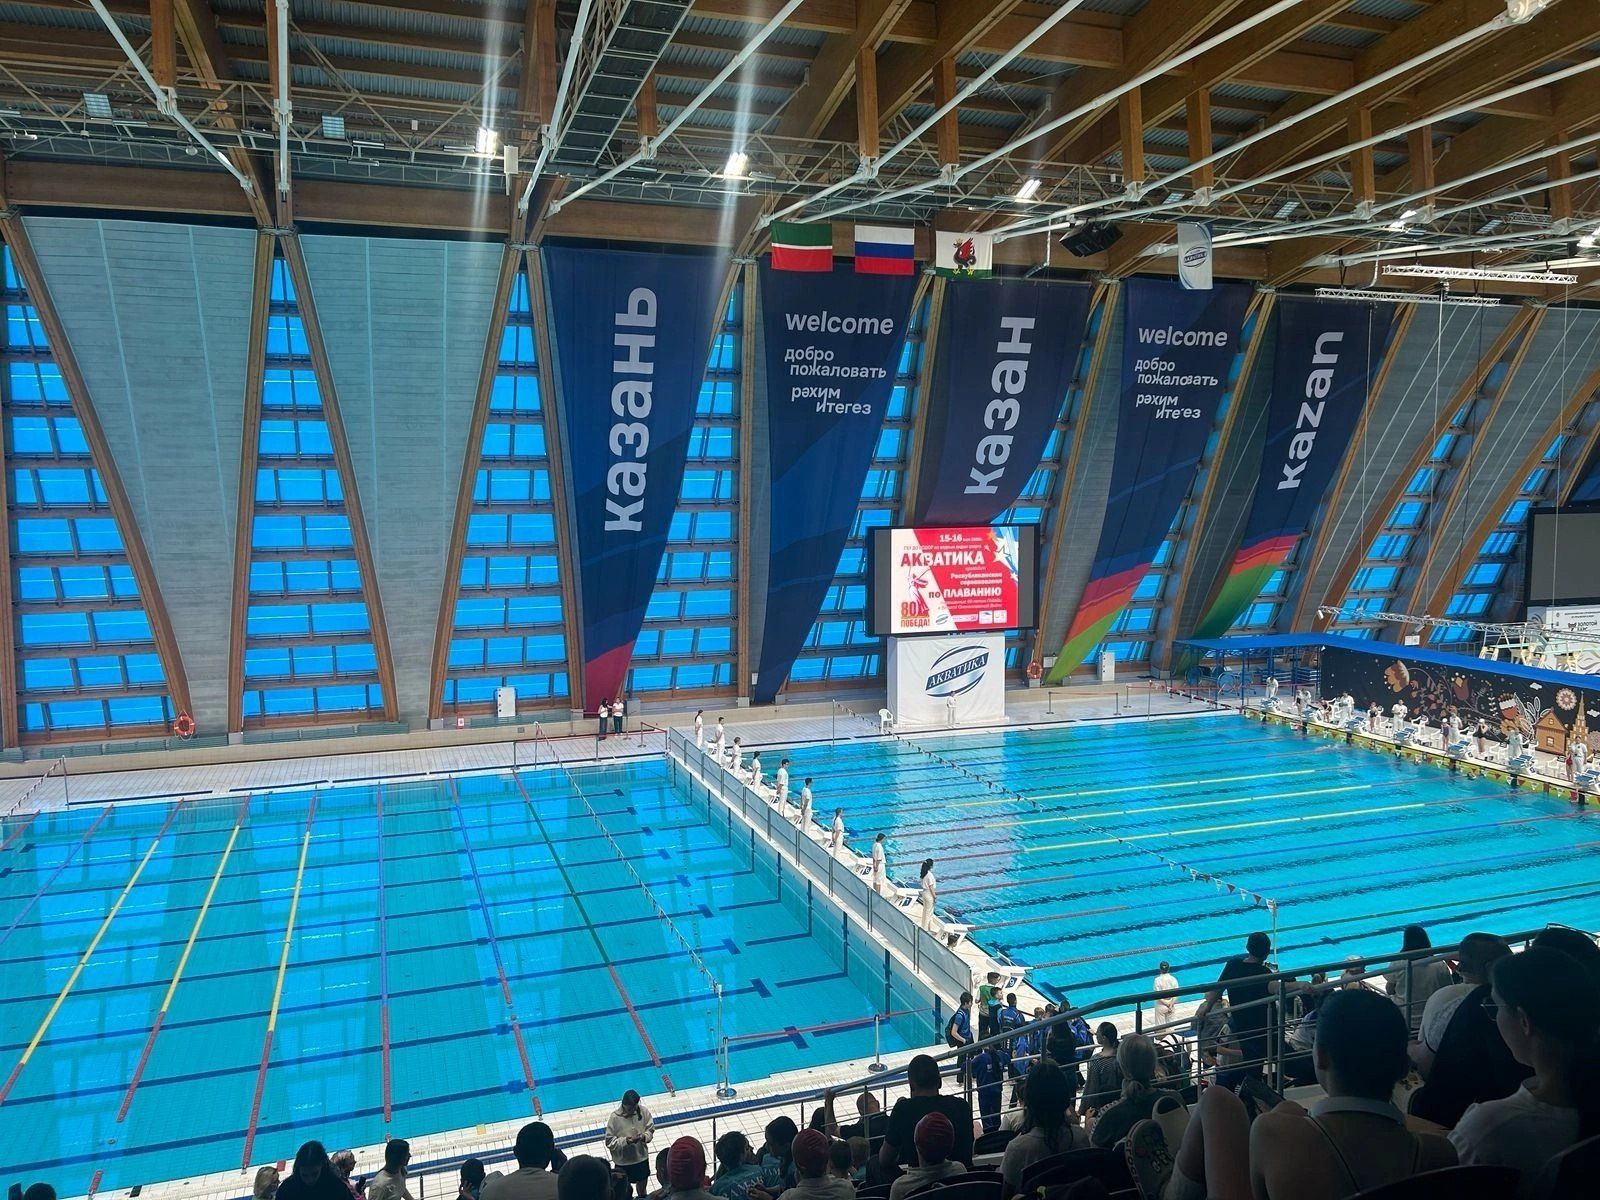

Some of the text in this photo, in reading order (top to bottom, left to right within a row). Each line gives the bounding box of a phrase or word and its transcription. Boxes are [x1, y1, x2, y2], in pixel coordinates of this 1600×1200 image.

[785, 310, 894, 335] welcome
[1138, 326, 1228, 346] welcome
[784, 346, 835, 364] добро
[789, 364, 887, 378] пожаловать
[1134, 356, 1176, 373] добро
[791, 386, 841, 402] рәхим
[1135, 393, 1179, 408] рәхим
[604, 287, 658, 532] казань
[816, 401, 872, 415] итегез
[963, 316, 1036, 495] казан
[1155, 408, 1201, 419] итеез
[1277, 331, 1345, 491] kazan
[940, 534, 963, 543] 15-16
[901, 551, 985, 567] АКВАТИКА
[943, 586, 1002, 598] ПЛАВАНИЮ
[901, 601, 918, 618] 80
[900, 618, 930, 628] ПОБЕДА!
[928, 655, 986, 688] АКВАТИКА
